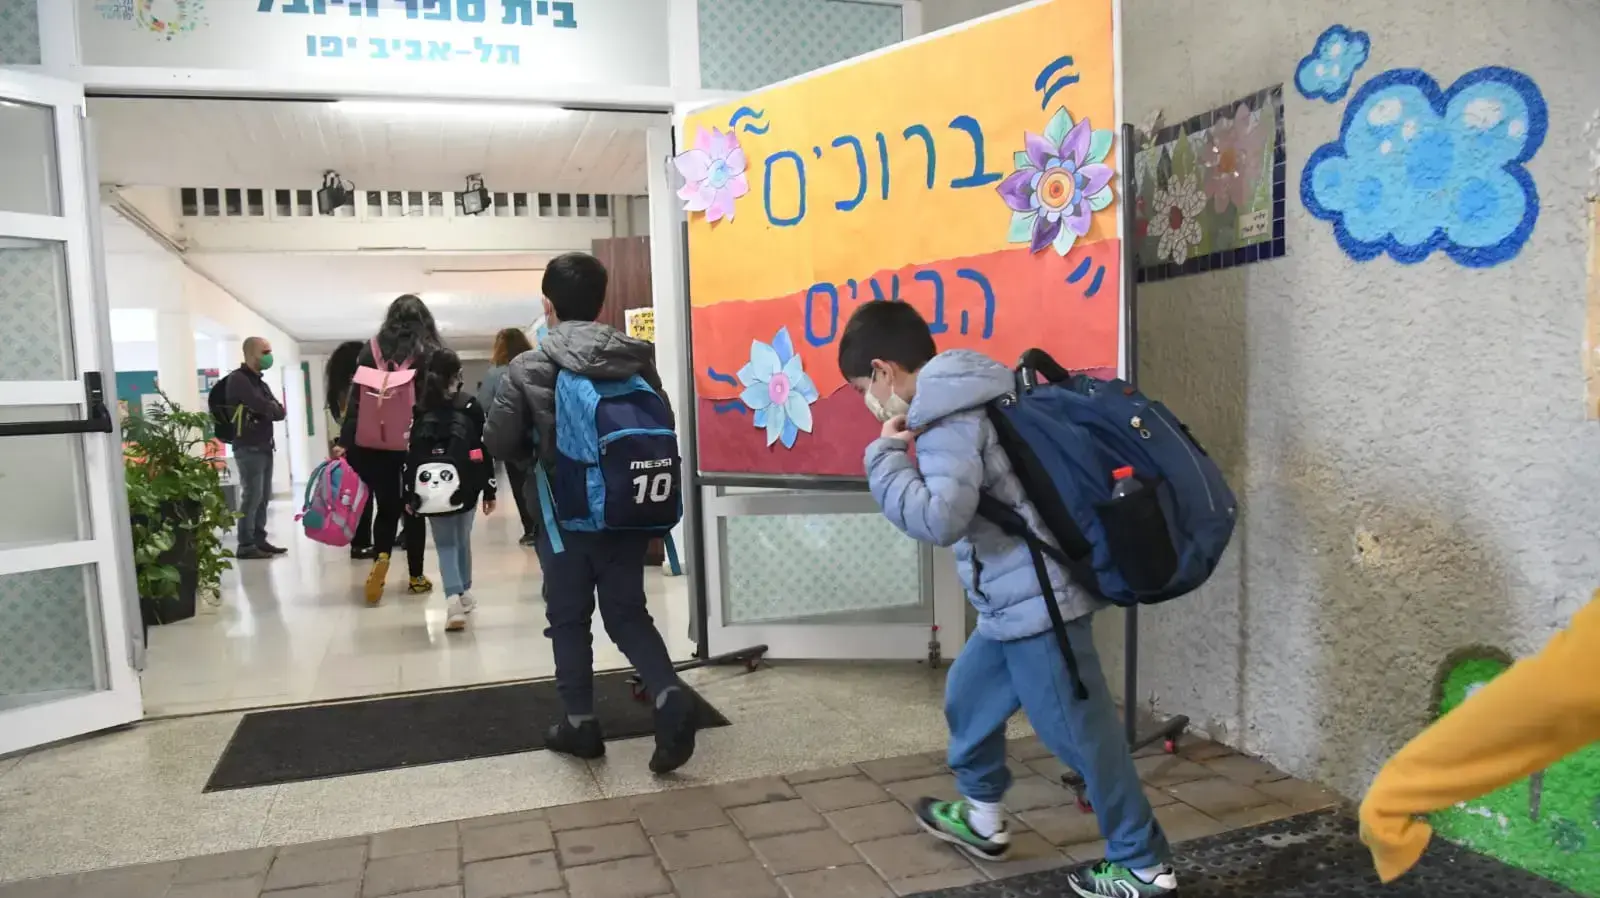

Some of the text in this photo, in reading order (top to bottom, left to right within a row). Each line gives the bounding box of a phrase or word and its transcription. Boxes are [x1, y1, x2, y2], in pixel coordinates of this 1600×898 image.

[394, 0, 486, 23] ספר
[501, 0, 577, 28] בית
[306, 34, 520, 65] תל-אביב יפו
[764, 115, 1004, 226] ברוכים
[630, 458, 672, 470] MESSI
[633, 473, 671, 504] 10
